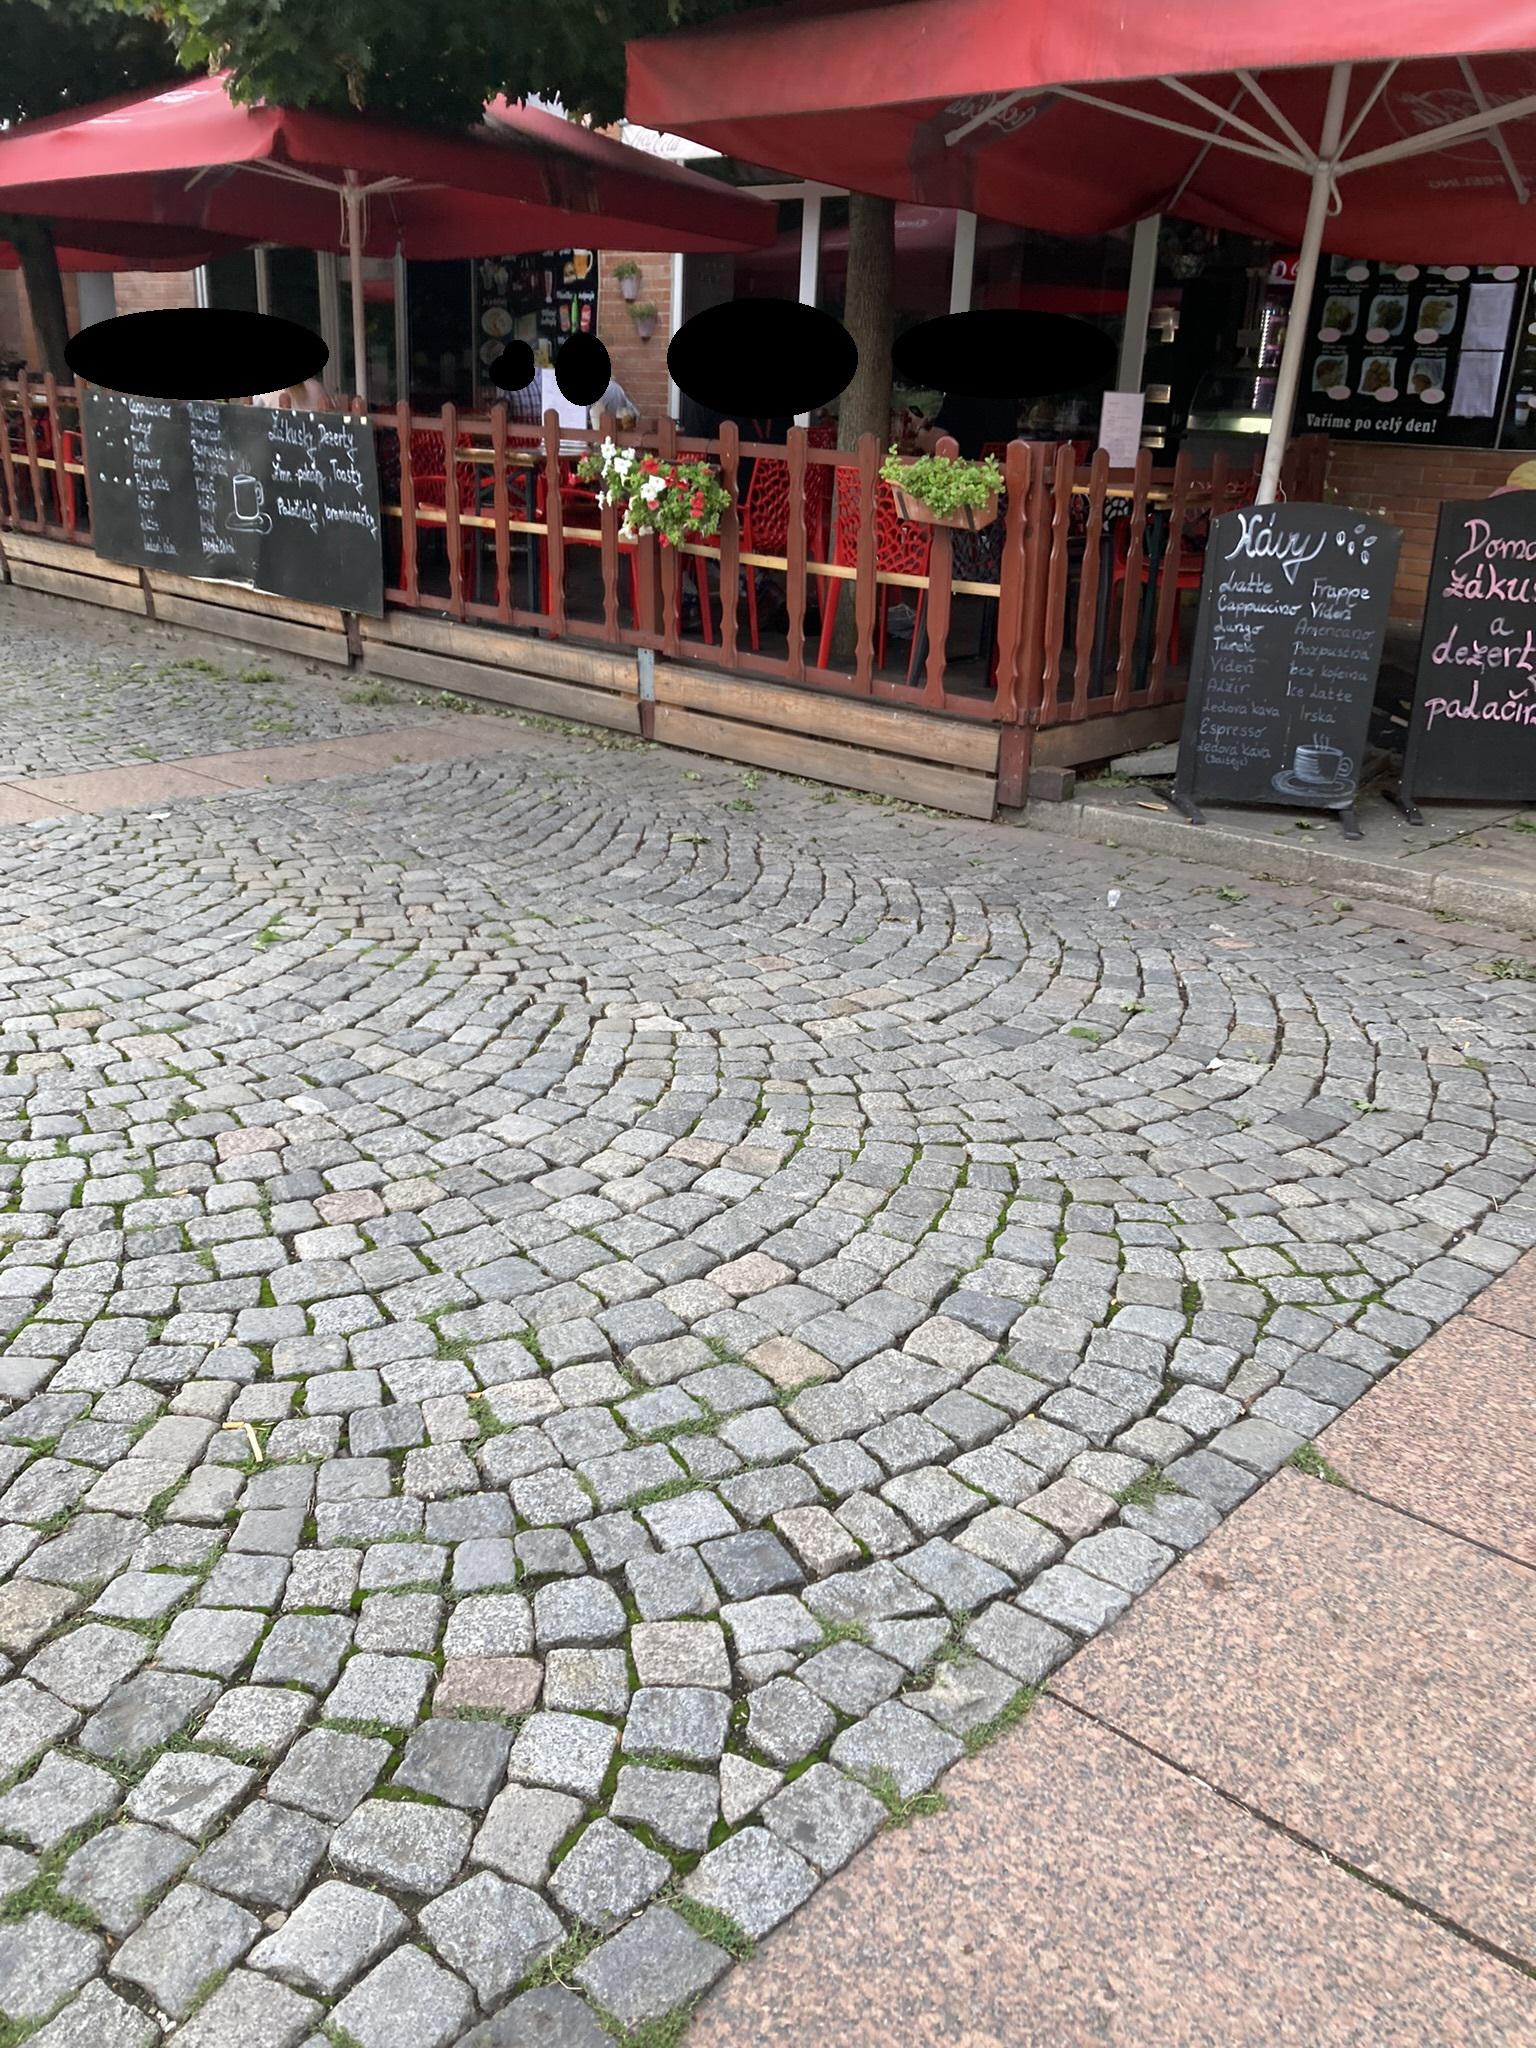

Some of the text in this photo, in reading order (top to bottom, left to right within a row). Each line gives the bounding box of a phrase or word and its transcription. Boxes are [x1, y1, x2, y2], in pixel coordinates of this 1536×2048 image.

[1307, 413, 1437, 434] Vaříme po celý den!
[1224, 512, 1327, 585] Kávy
[1219, 570, 1274, 594] Latte
[1218, 595, 1302, 618] Cappuccino
[1214, 616, 1264, 641] Lungo
[1295, 618, 1375, 641] Americano
[1490, 617, 1514, 636] a
[1310, 683, 1353, 704] Latte
[1199, 718, 1267, 741] Espresso
